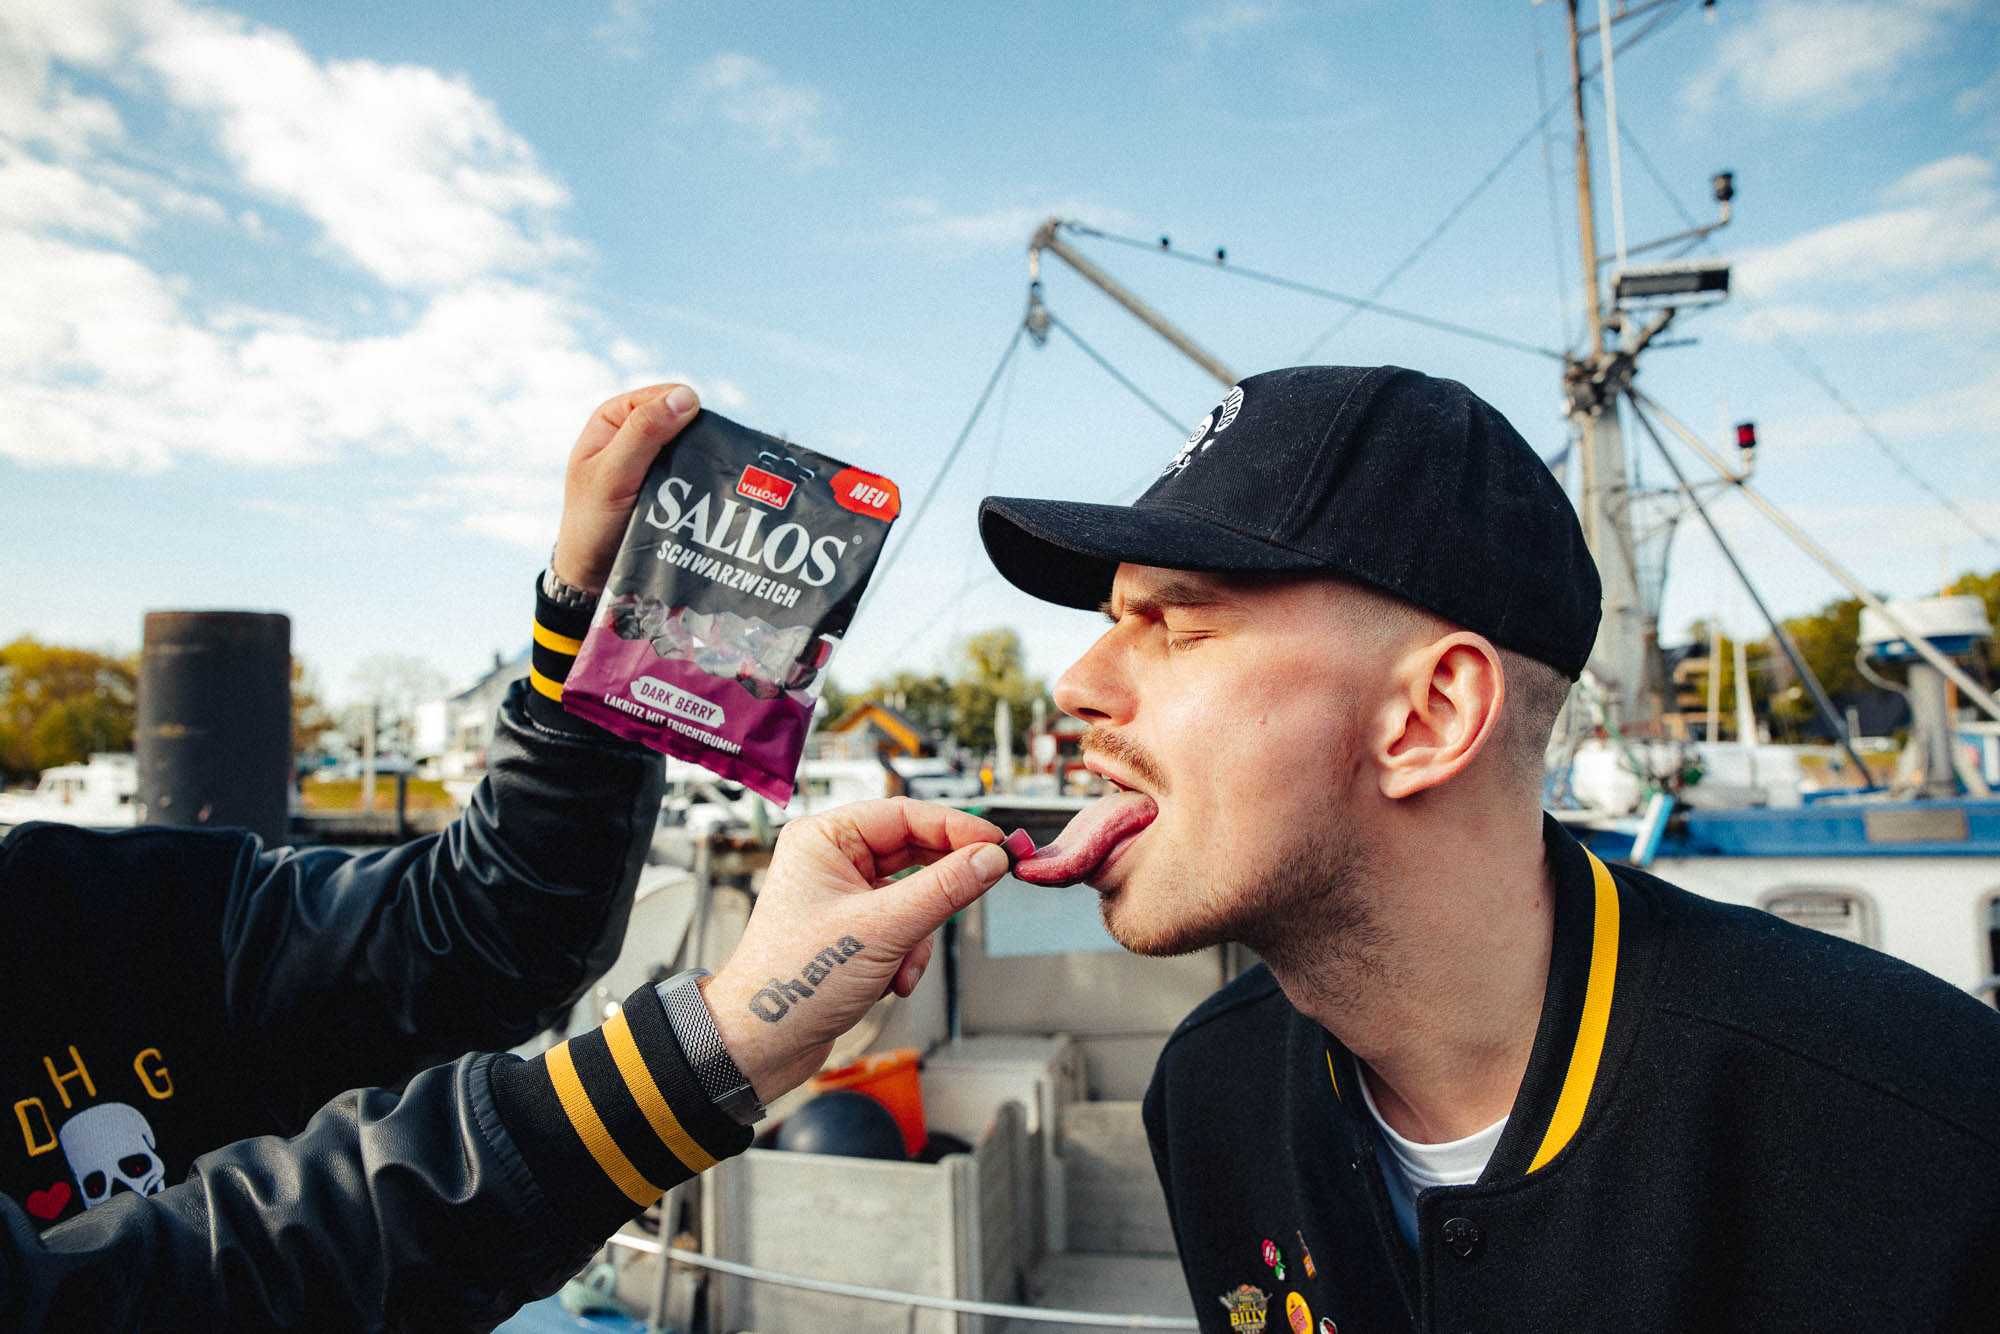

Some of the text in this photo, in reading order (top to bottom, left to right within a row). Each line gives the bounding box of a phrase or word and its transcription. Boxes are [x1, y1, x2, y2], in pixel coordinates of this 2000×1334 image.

[741, 482, 784, 507] VILLOSA
[849, 482, 891, 509] NEU
[645, 476, 848, 588] SALLOS
[656, 540, 802, 609] SCHWARZWEICH
[604, 693, 646, 719] LAKRITZ
[645, 709, 667, 726] MIT
[640, 682, 717, 721] DARK BERRY
[750, 935, 865, 1023] Ohana
[1230, 1309, 1267, 1326] BILLY
